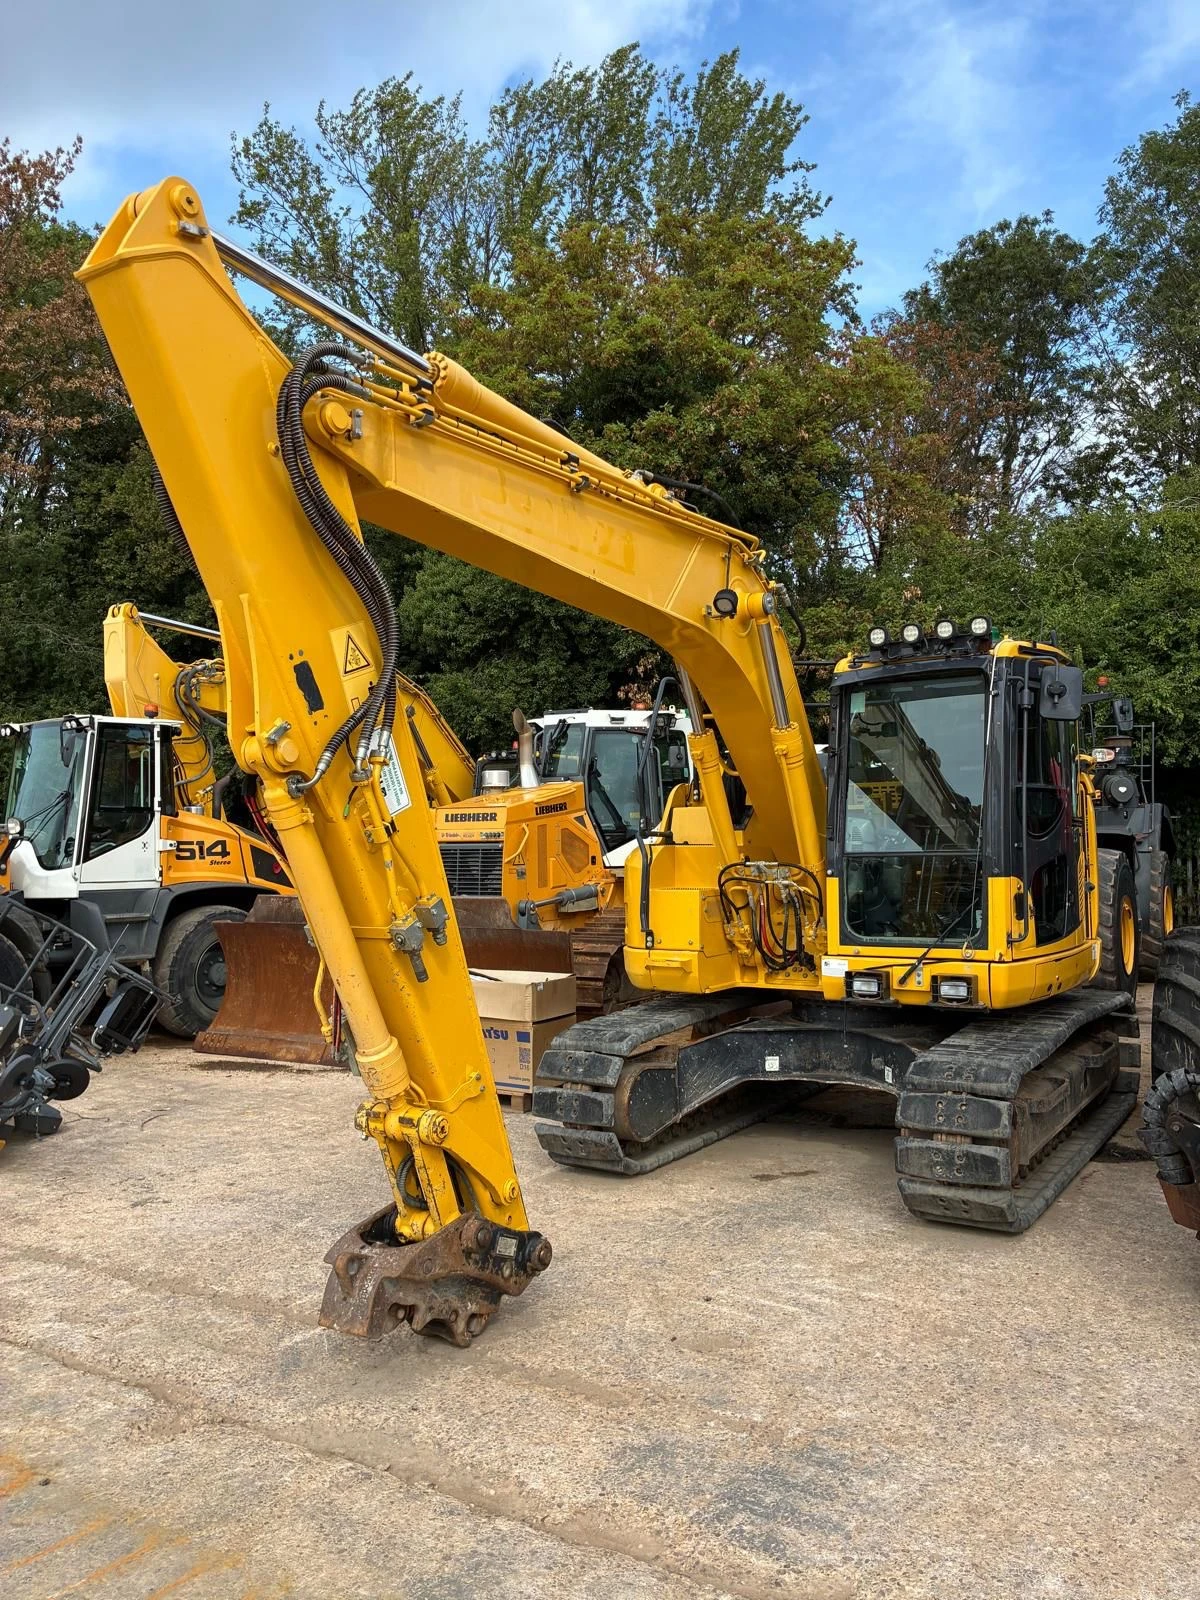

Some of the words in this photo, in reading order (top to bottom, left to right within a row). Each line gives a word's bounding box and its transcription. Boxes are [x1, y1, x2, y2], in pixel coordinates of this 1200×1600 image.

[535, 802, 567, 815] LIEBHERR
[445, 812, 497, 822] LIEBHERR
[176, 840, 230, 860] 514
[482, 1026, 509, 1041] ATSU
